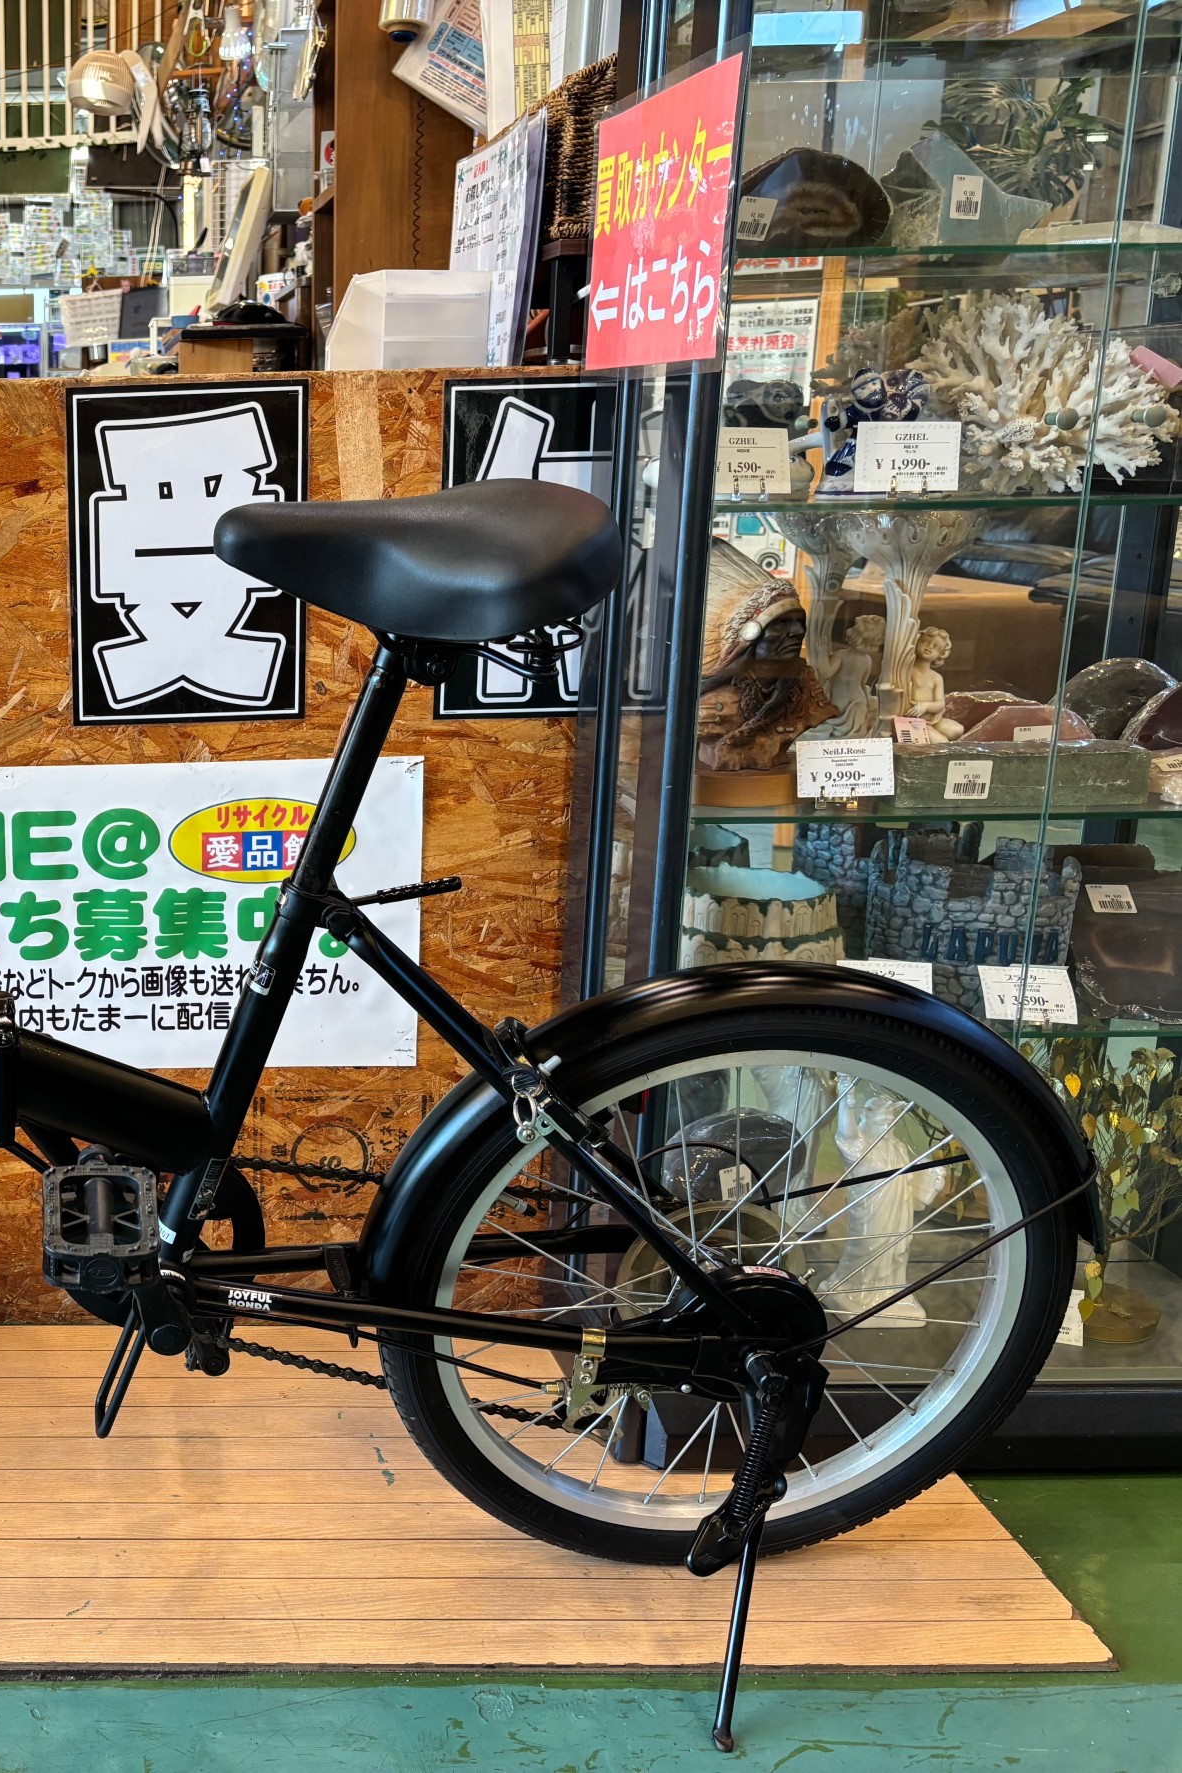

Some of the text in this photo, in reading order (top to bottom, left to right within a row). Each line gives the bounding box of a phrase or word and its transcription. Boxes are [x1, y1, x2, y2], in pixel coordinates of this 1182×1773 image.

[594, 117, 732, 240] 買取カウンター
[622, 240, 716, 331] はこちら
[729, 437, 758, 445] GZHEL
[895, 433, 929, 441] GZHEL
[217, 804, 310, 829] リサイクル
[866, 969, 905, 978] ランター
[319, 1155, 342, 1194] JS
[228, 1289, 272, 1303] JOYFUL
[228, 1299, 271, 1311] HONDA
